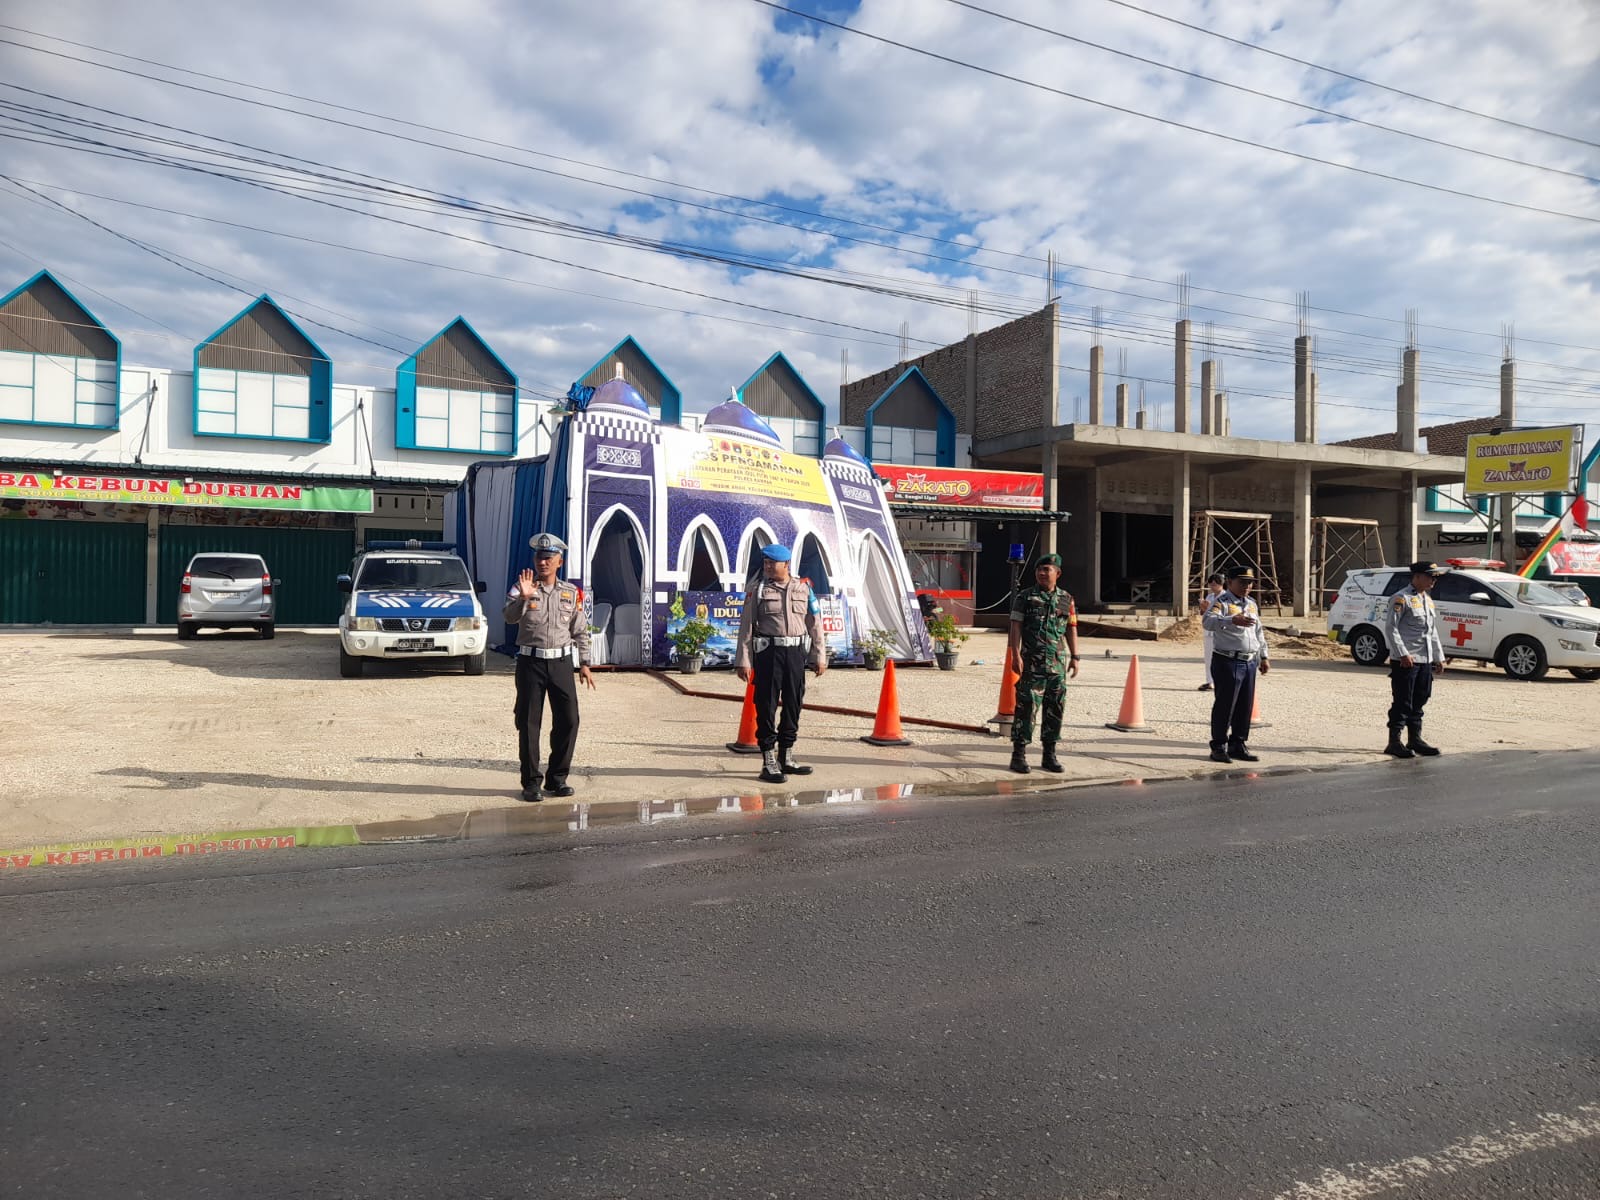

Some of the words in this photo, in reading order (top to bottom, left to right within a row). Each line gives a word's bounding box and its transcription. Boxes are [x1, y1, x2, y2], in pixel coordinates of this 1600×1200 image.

[1476, 444, 1518, 457] RUMAH
[1519, 440, 1563, 454] MAKAN
[722, 453, 804, 476] PENGAMANAN
[1484, 466, 1552, 482] ZAKATO
[53, 475, 170, 494] KEBUN
[183, 482, 302, 500] DURIAN
[897, 479, 971, 497] ZAKATO
[713, 607, 741, 618] IDUL
[1442, 616, 1484, 625] AMBULANCE
